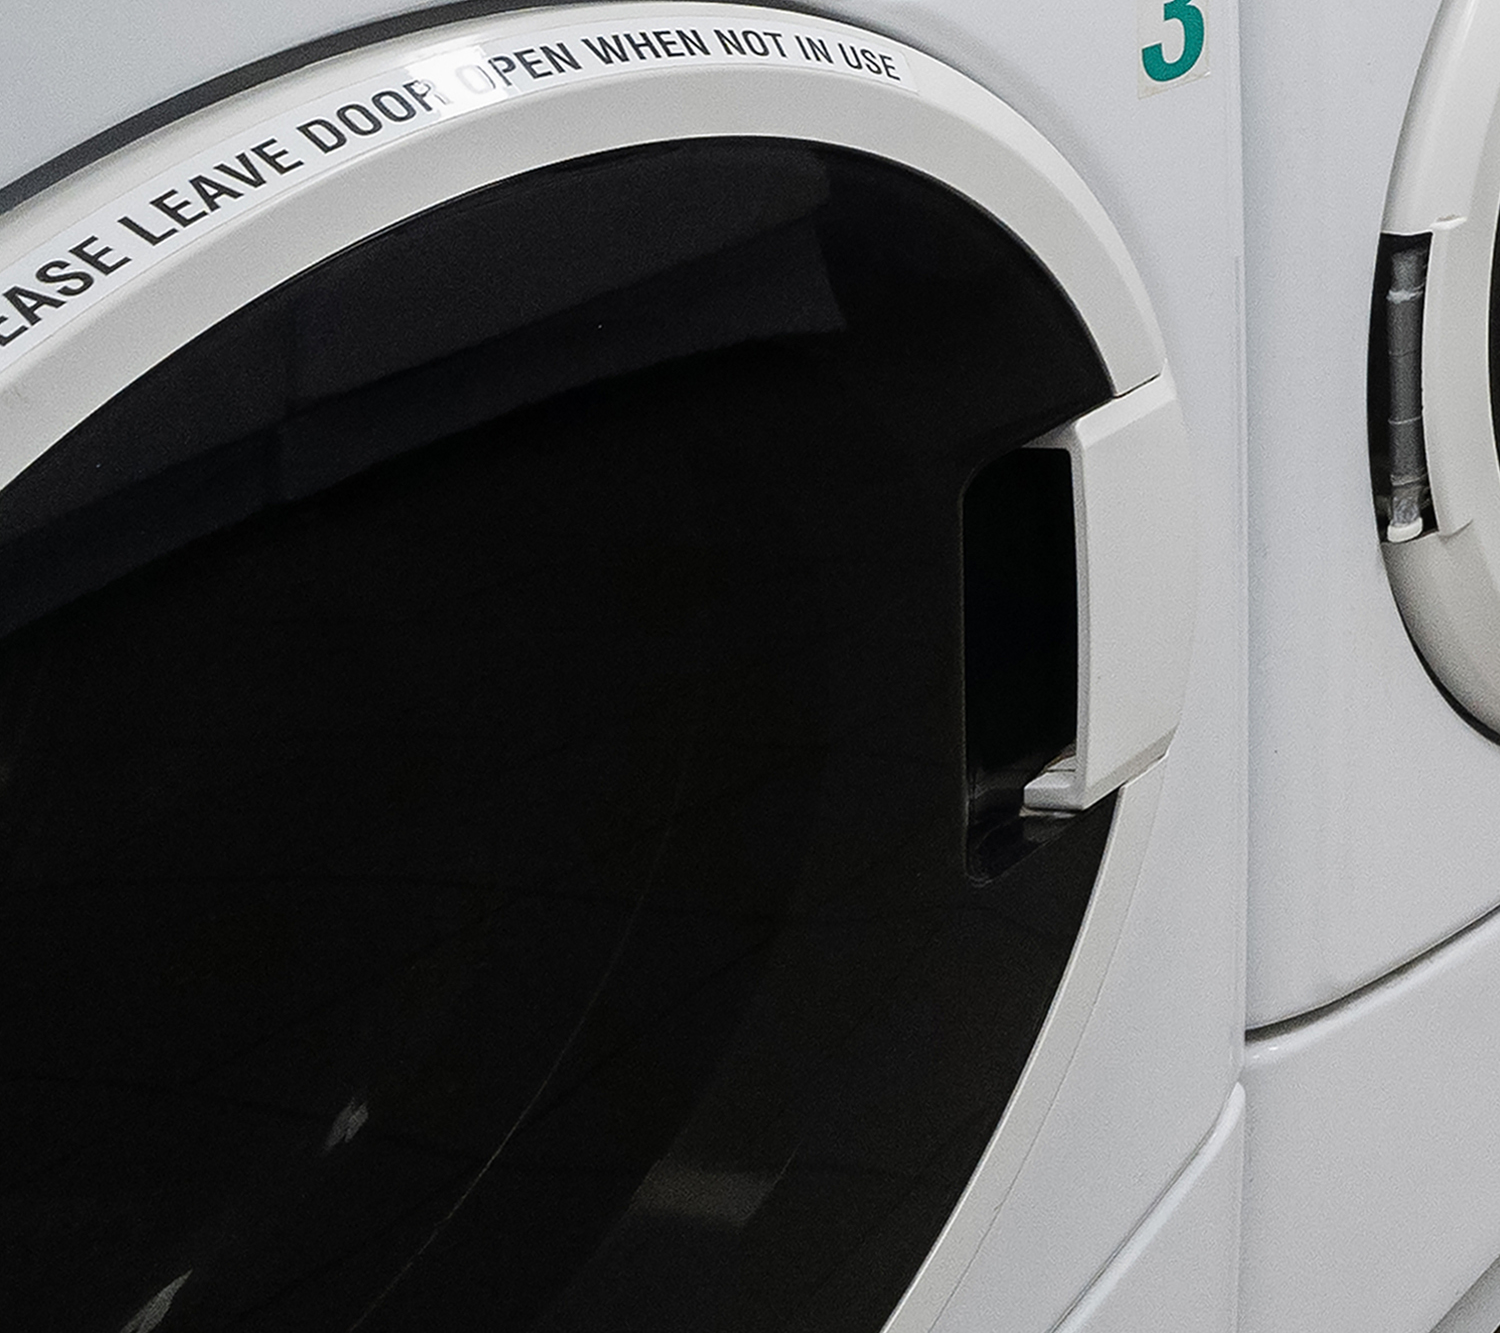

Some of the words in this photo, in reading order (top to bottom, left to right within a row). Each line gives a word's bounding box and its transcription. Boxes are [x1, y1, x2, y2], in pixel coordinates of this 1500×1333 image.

[0, 236, 132, 347] EASE
[117, 139, 304, 246] LEAVE
[296, 79, 450, 155] DOOR
[582, 29, 707, 66] WHEN
[713, 28, 786, 59] NOT
[794, 34, 834, 64] IN
[838, 42, 903, 82] USE
